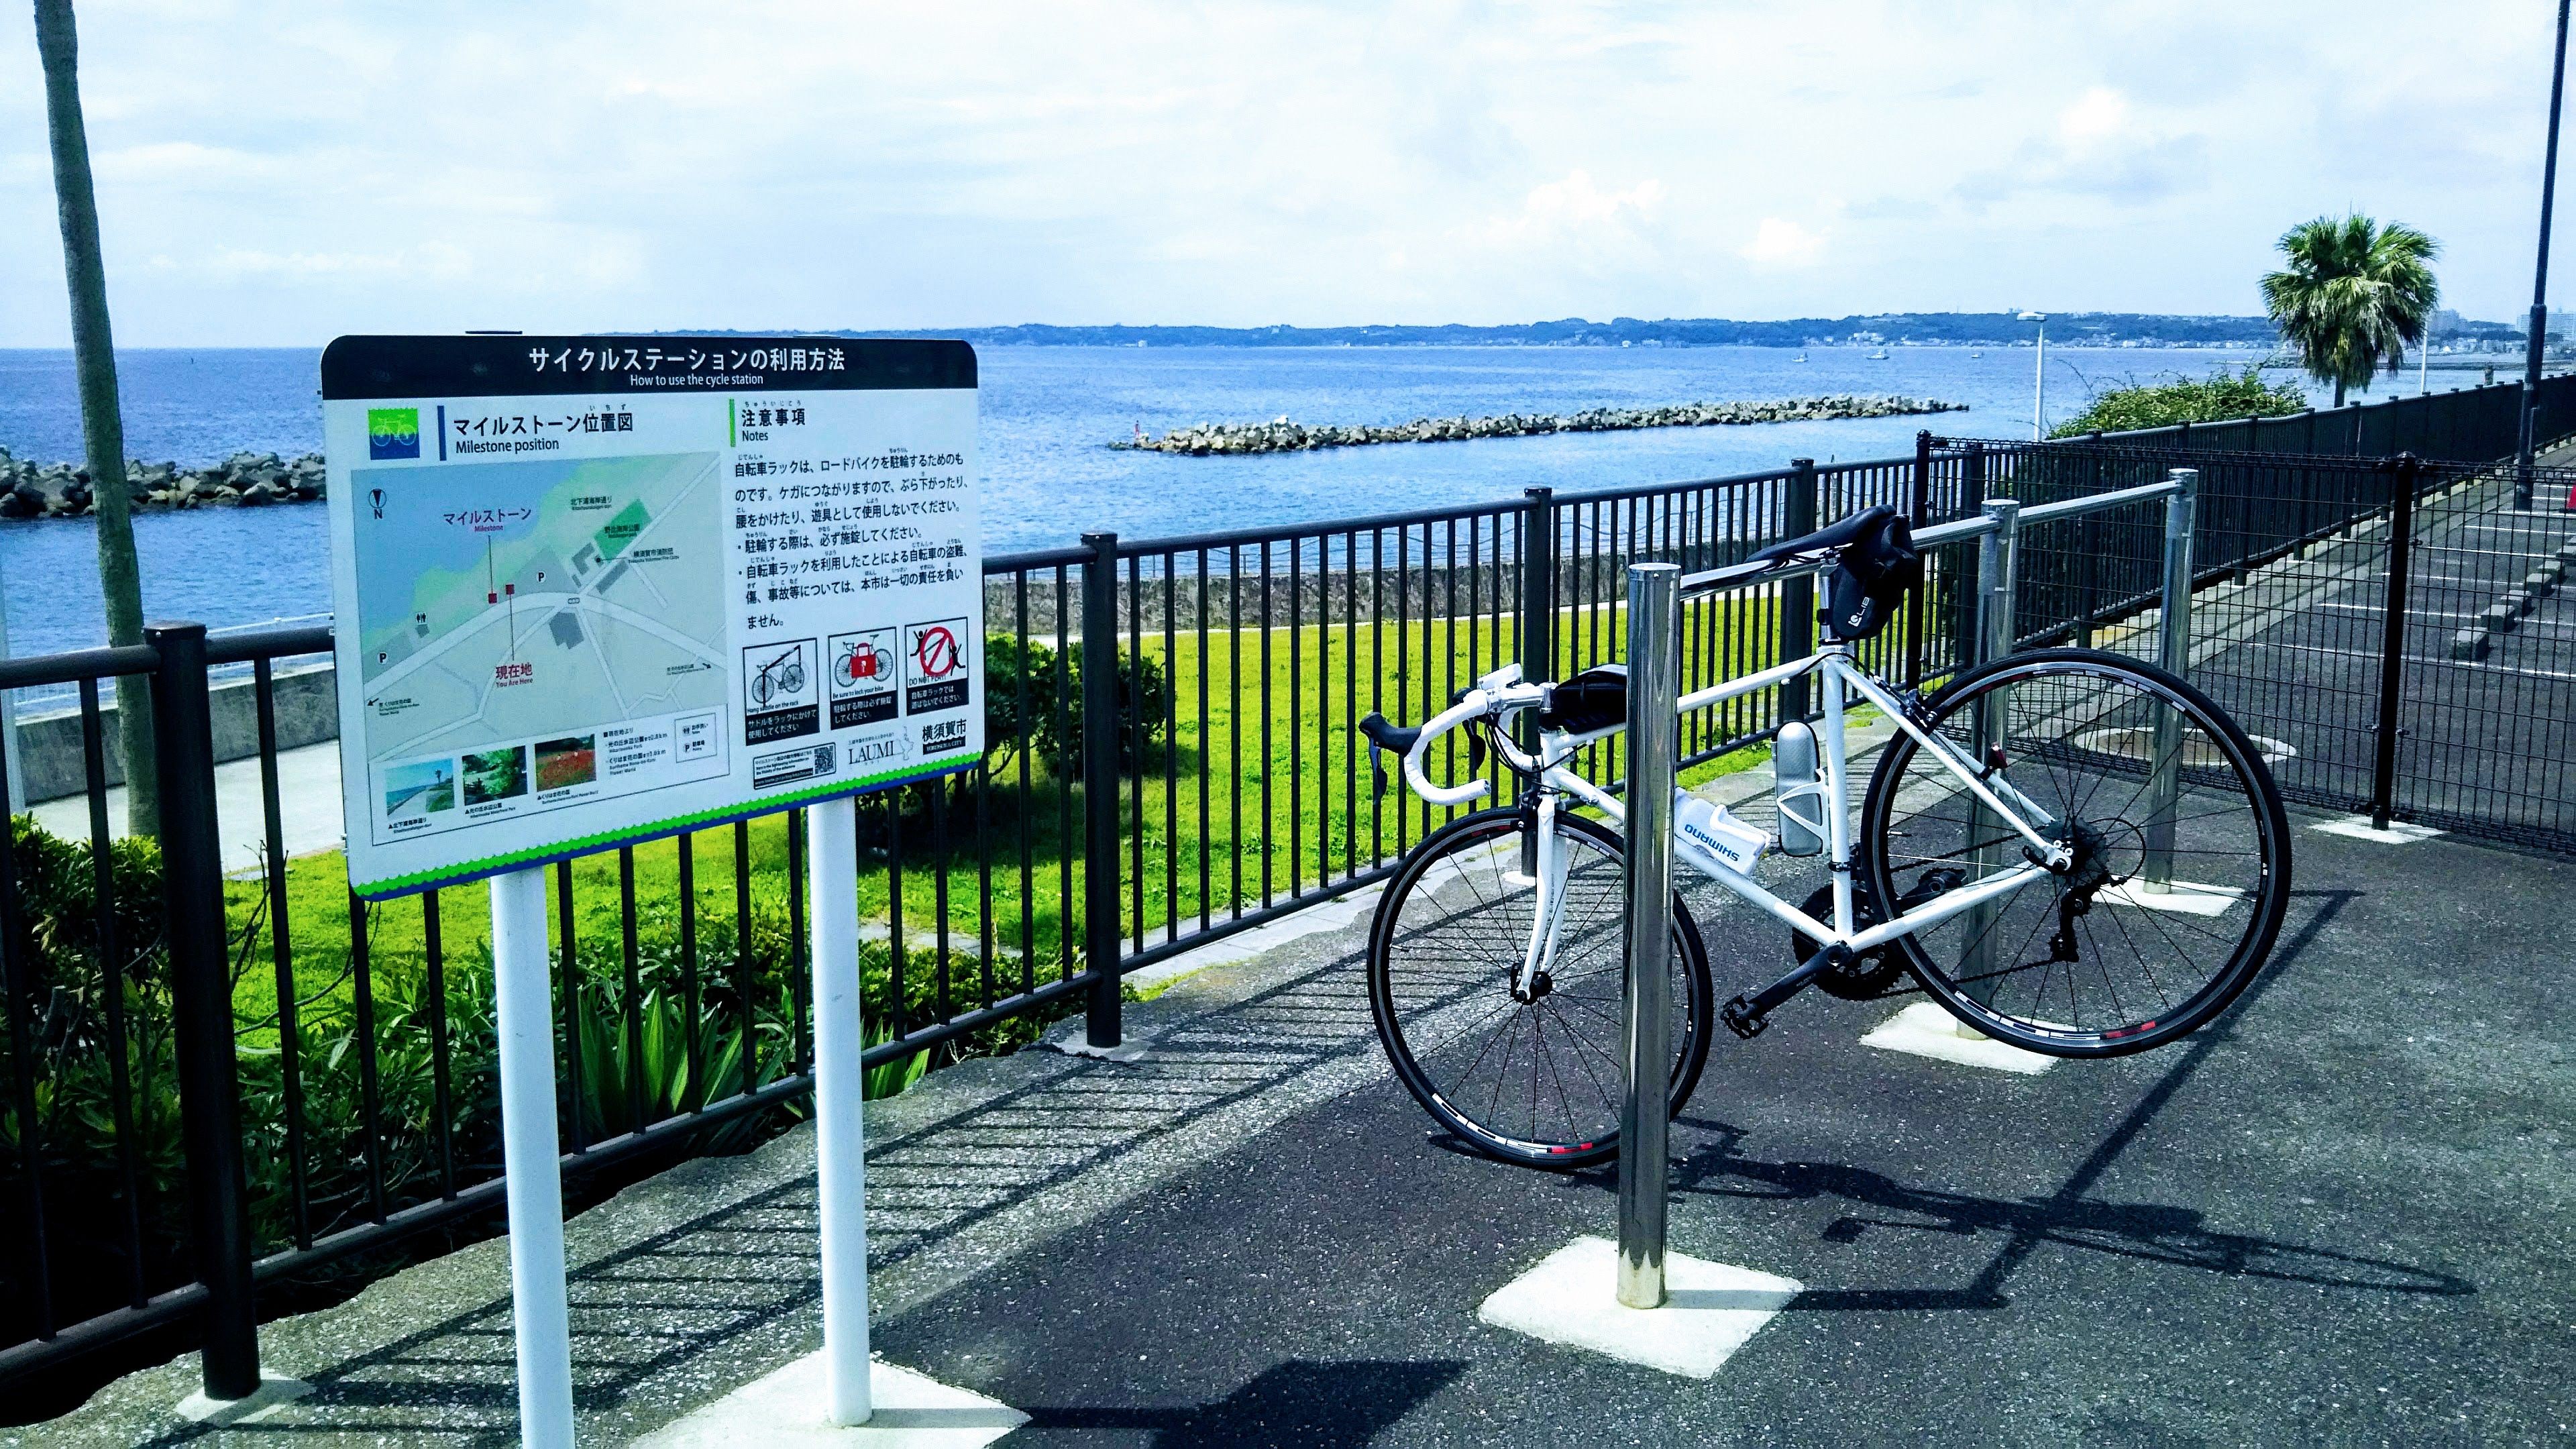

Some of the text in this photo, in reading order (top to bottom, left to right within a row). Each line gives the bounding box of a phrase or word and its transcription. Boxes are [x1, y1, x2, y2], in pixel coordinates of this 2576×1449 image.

[529, 347, 845, 372] サイクルステーションの利用方法
[631, 372, 764, 388] How to use the cycle station
[453, 413, 633, 437] マイルストーン位置図
[741, 407, 806, 427] 注意事項
[742, 431, 768, 441] Notes
[455, 437, 559, 454] Milestone position
[735, 452, 963, 477] 自転車ラックは、ロードバイクを駐輪するためのも
[374, 508, 383, 519] N
[443, 508, 532, 525] マイルストーン
[736, 500, 961, 529] 腰をかけたり、遊具として使用しないでください。
[474, 524, 503, 532] Milestone
[539, 572, 545, 582] P
[748, 613, 784, 629] ません。
[380, 653, 386, 663] P
[495, 661, 533, 680] 現在地
[909, 677, 918, 686] DO
[748, 709, 817, 729] サドルをラックにかけて
[922, 718, 967, 742] 横須賀市
[848, 740, 895, 765] LAUMI
[926, 742, 951, 751] YOKOSUKA
[1684, 824, 1740, 862] SHIMANO
